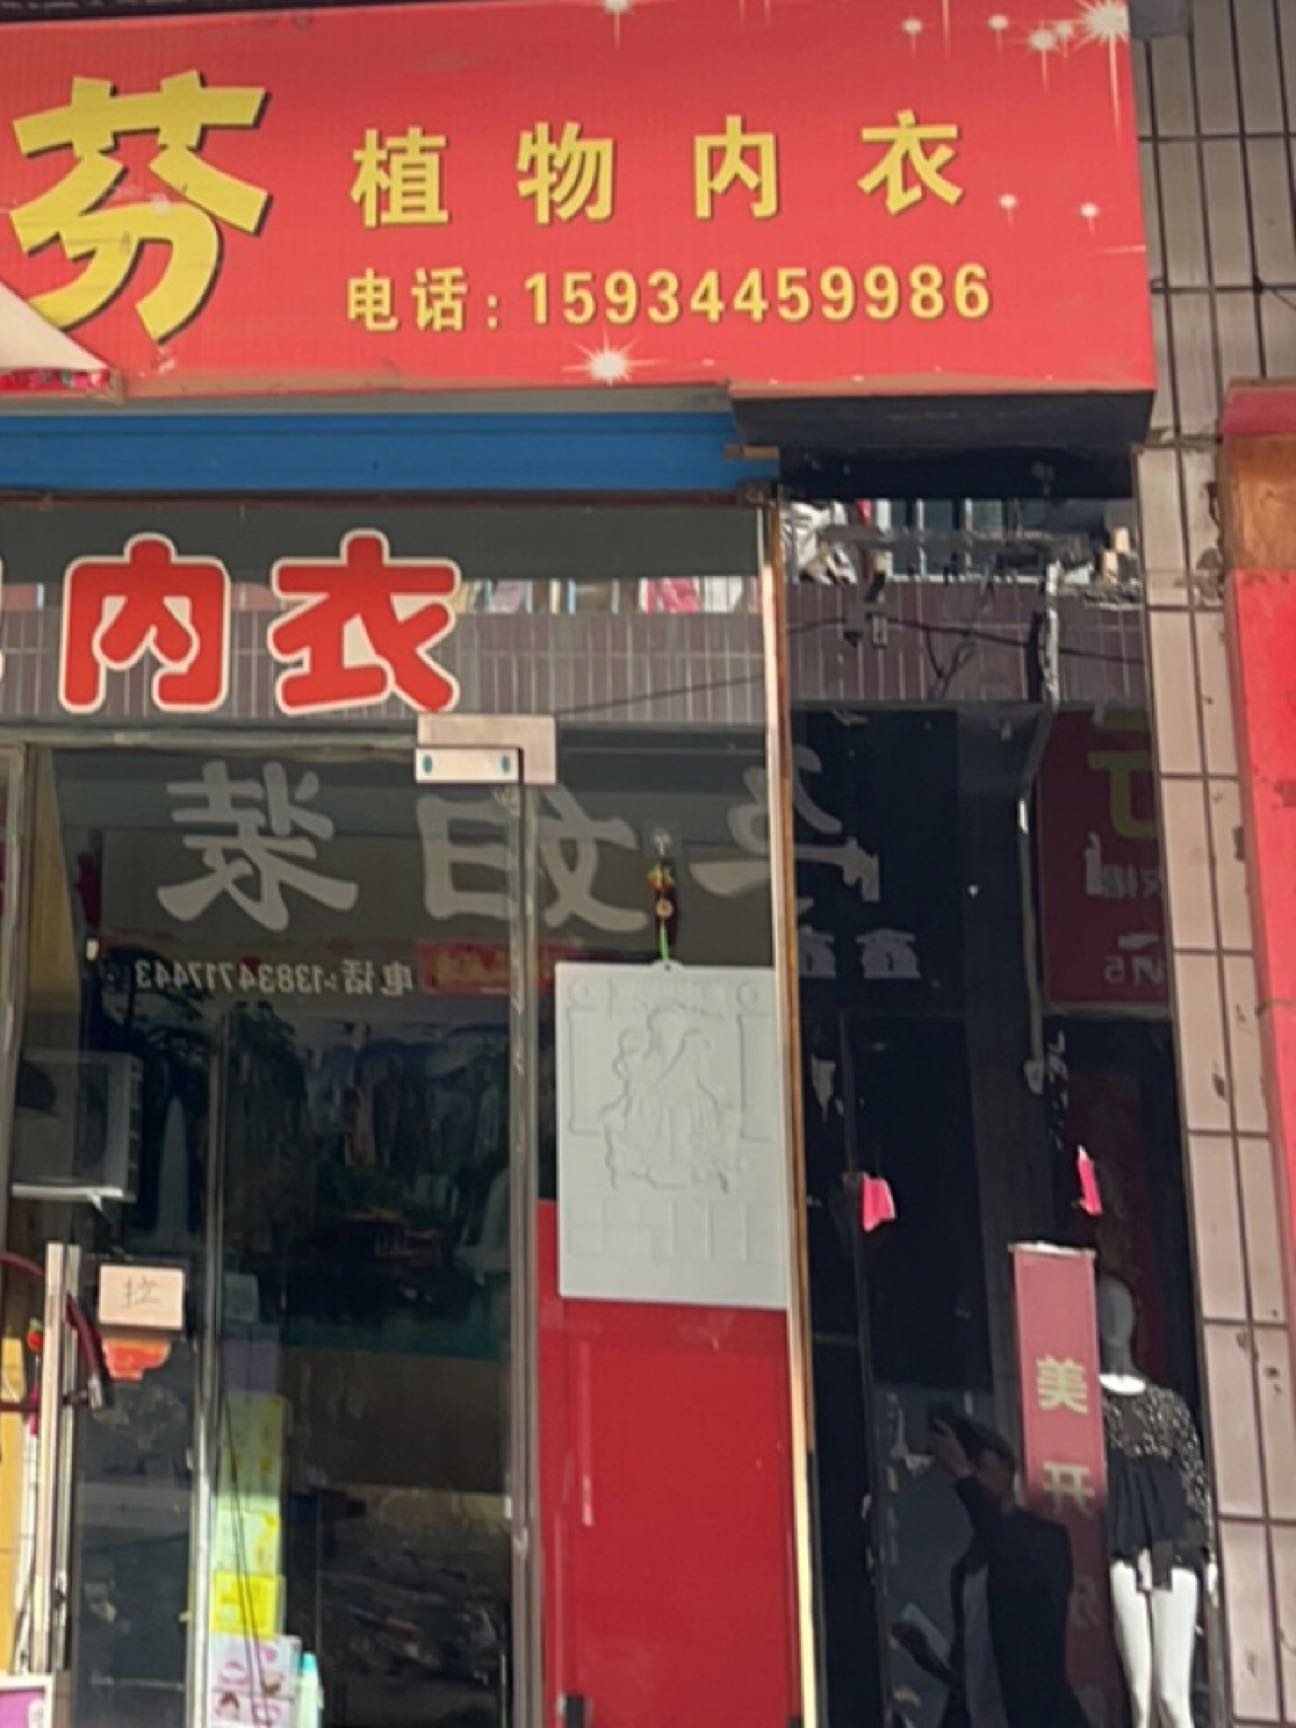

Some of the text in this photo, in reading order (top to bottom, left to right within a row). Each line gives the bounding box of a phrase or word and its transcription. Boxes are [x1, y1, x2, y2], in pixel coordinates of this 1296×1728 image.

[349, 109, 964, 228] 植物内衣
[346, 262, 992, 335] 电话:15934459986
